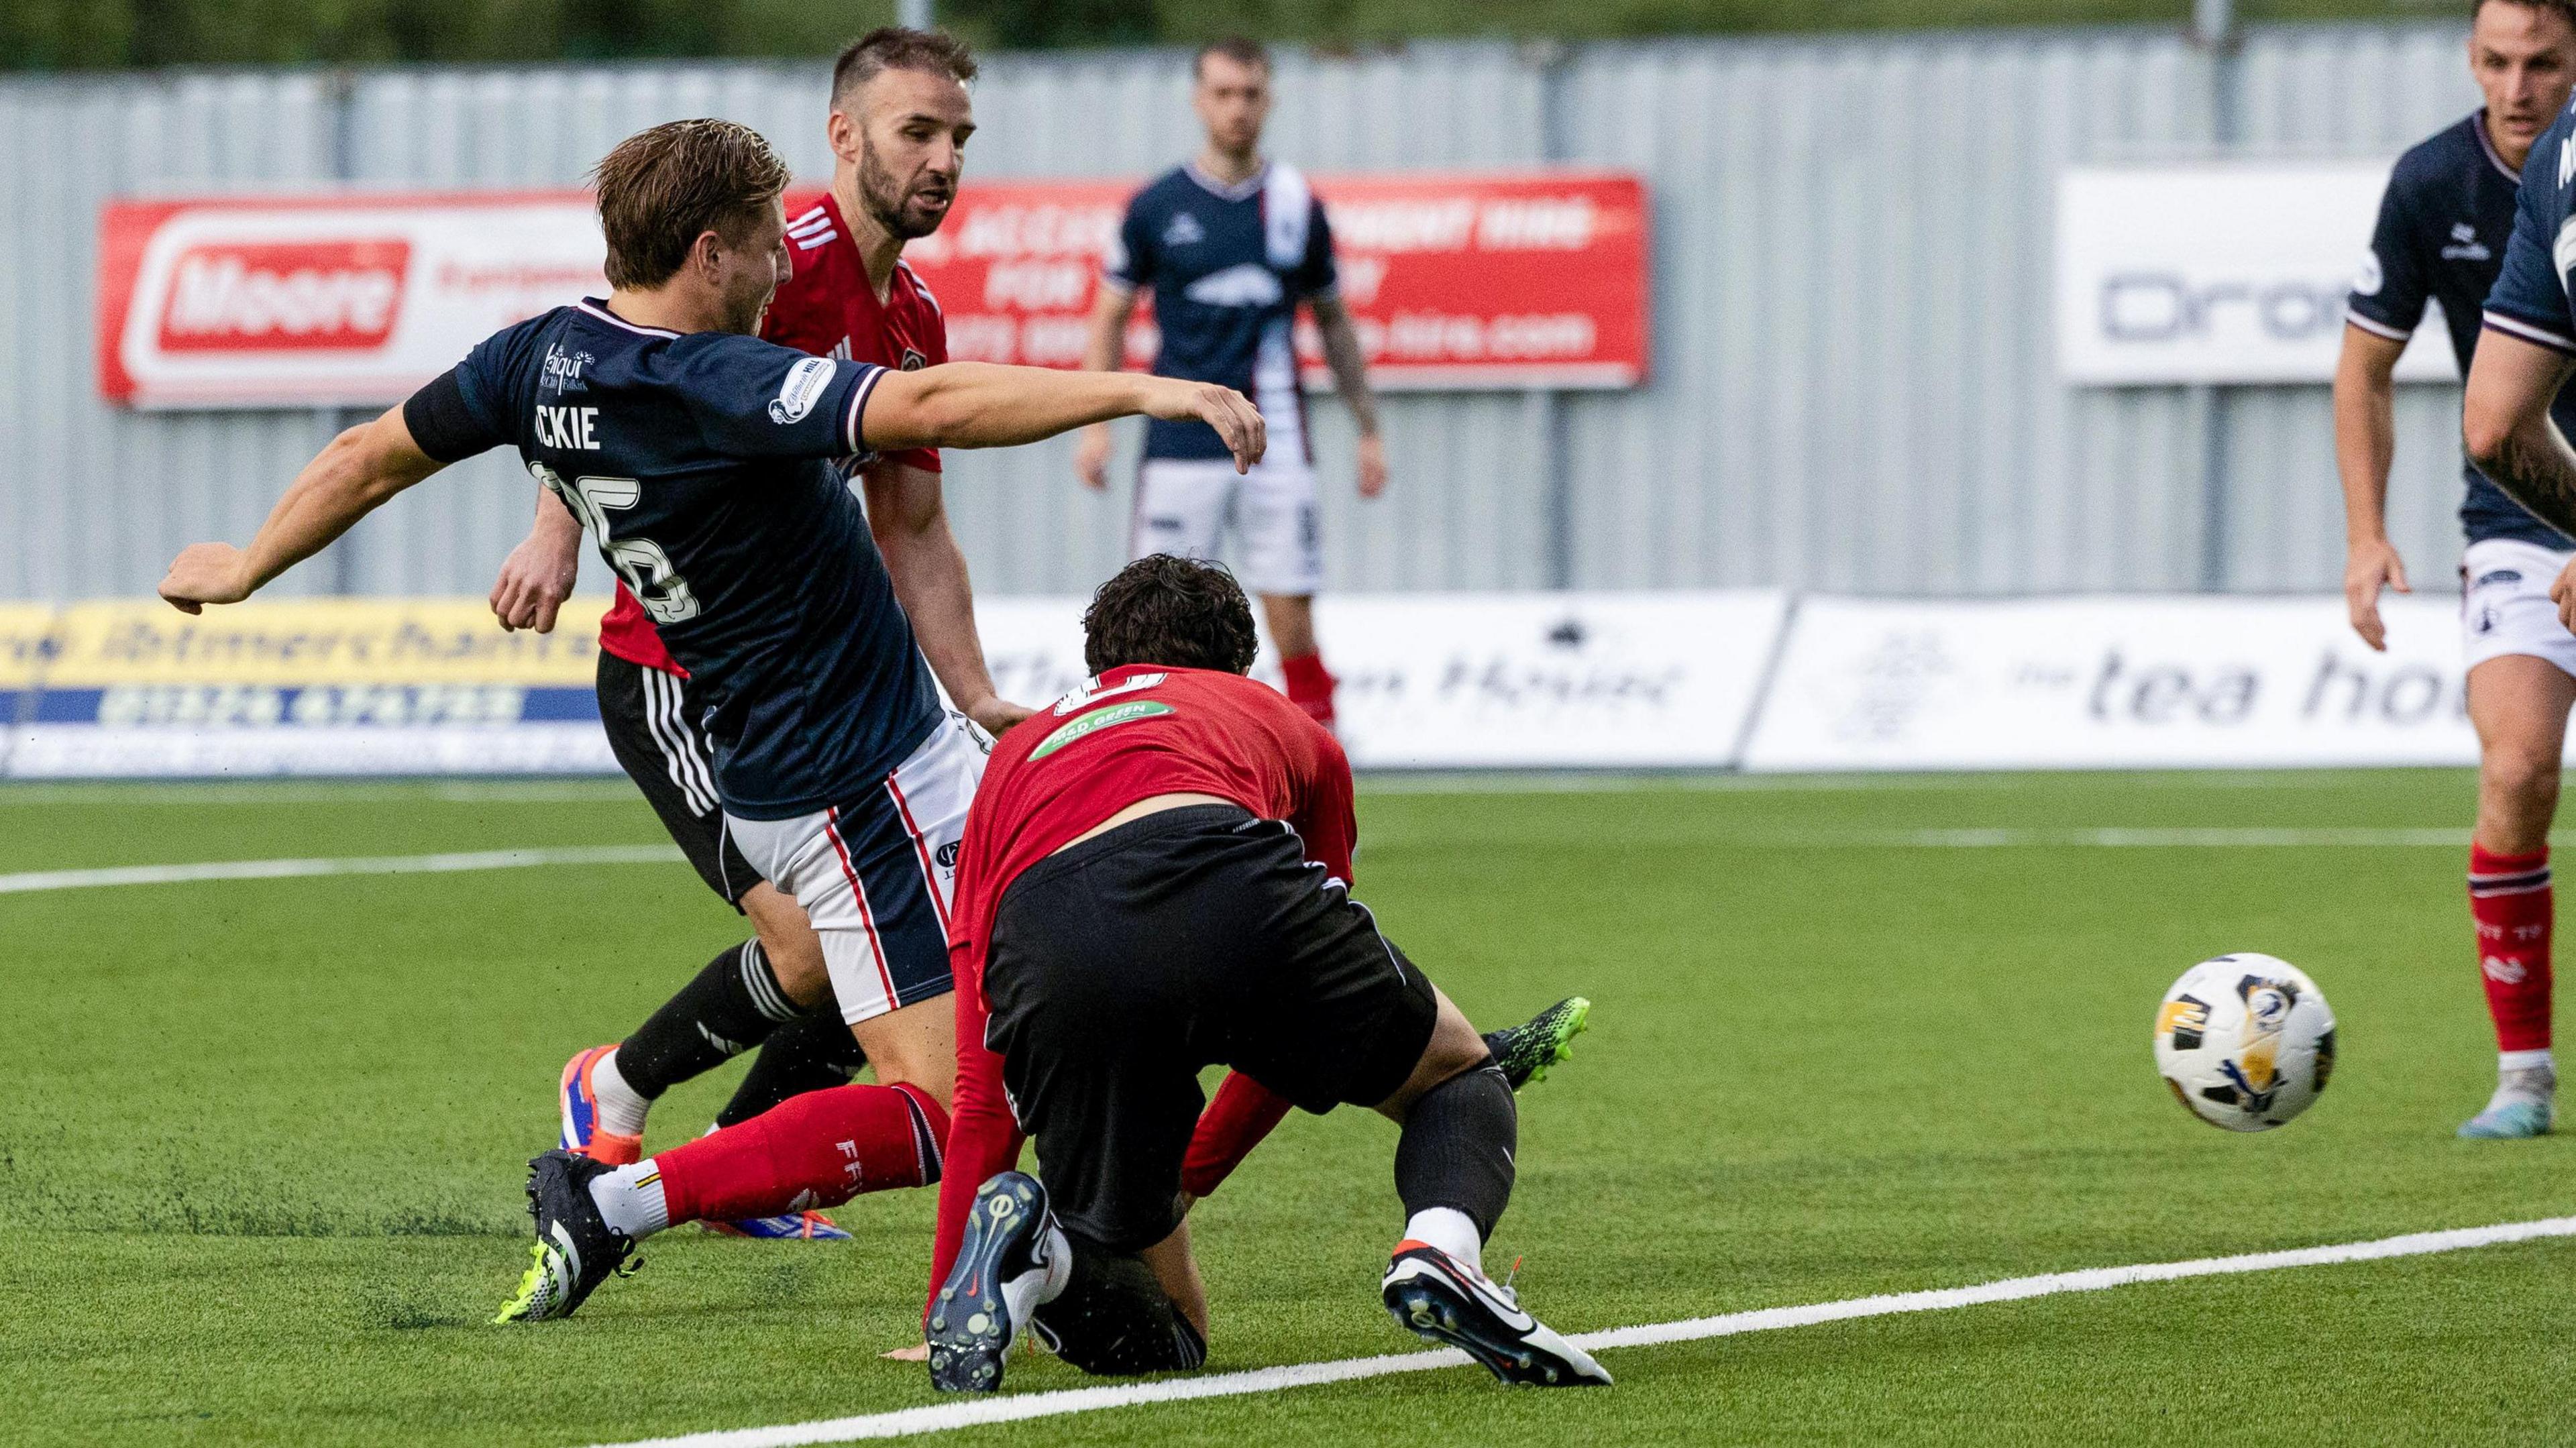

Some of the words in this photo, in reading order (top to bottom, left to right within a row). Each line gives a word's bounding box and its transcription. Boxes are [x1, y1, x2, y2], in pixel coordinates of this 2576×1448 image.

[171, 259, 396, 330] Moore
[1356, 311, 1595, 359] -hire.com
[803, 360, 820, 374] HILL
[2088, 648, 2259, 722] tea
[2300, 647, 2469, 723] ho
[1093, 704, 1146, 727] GREEN
